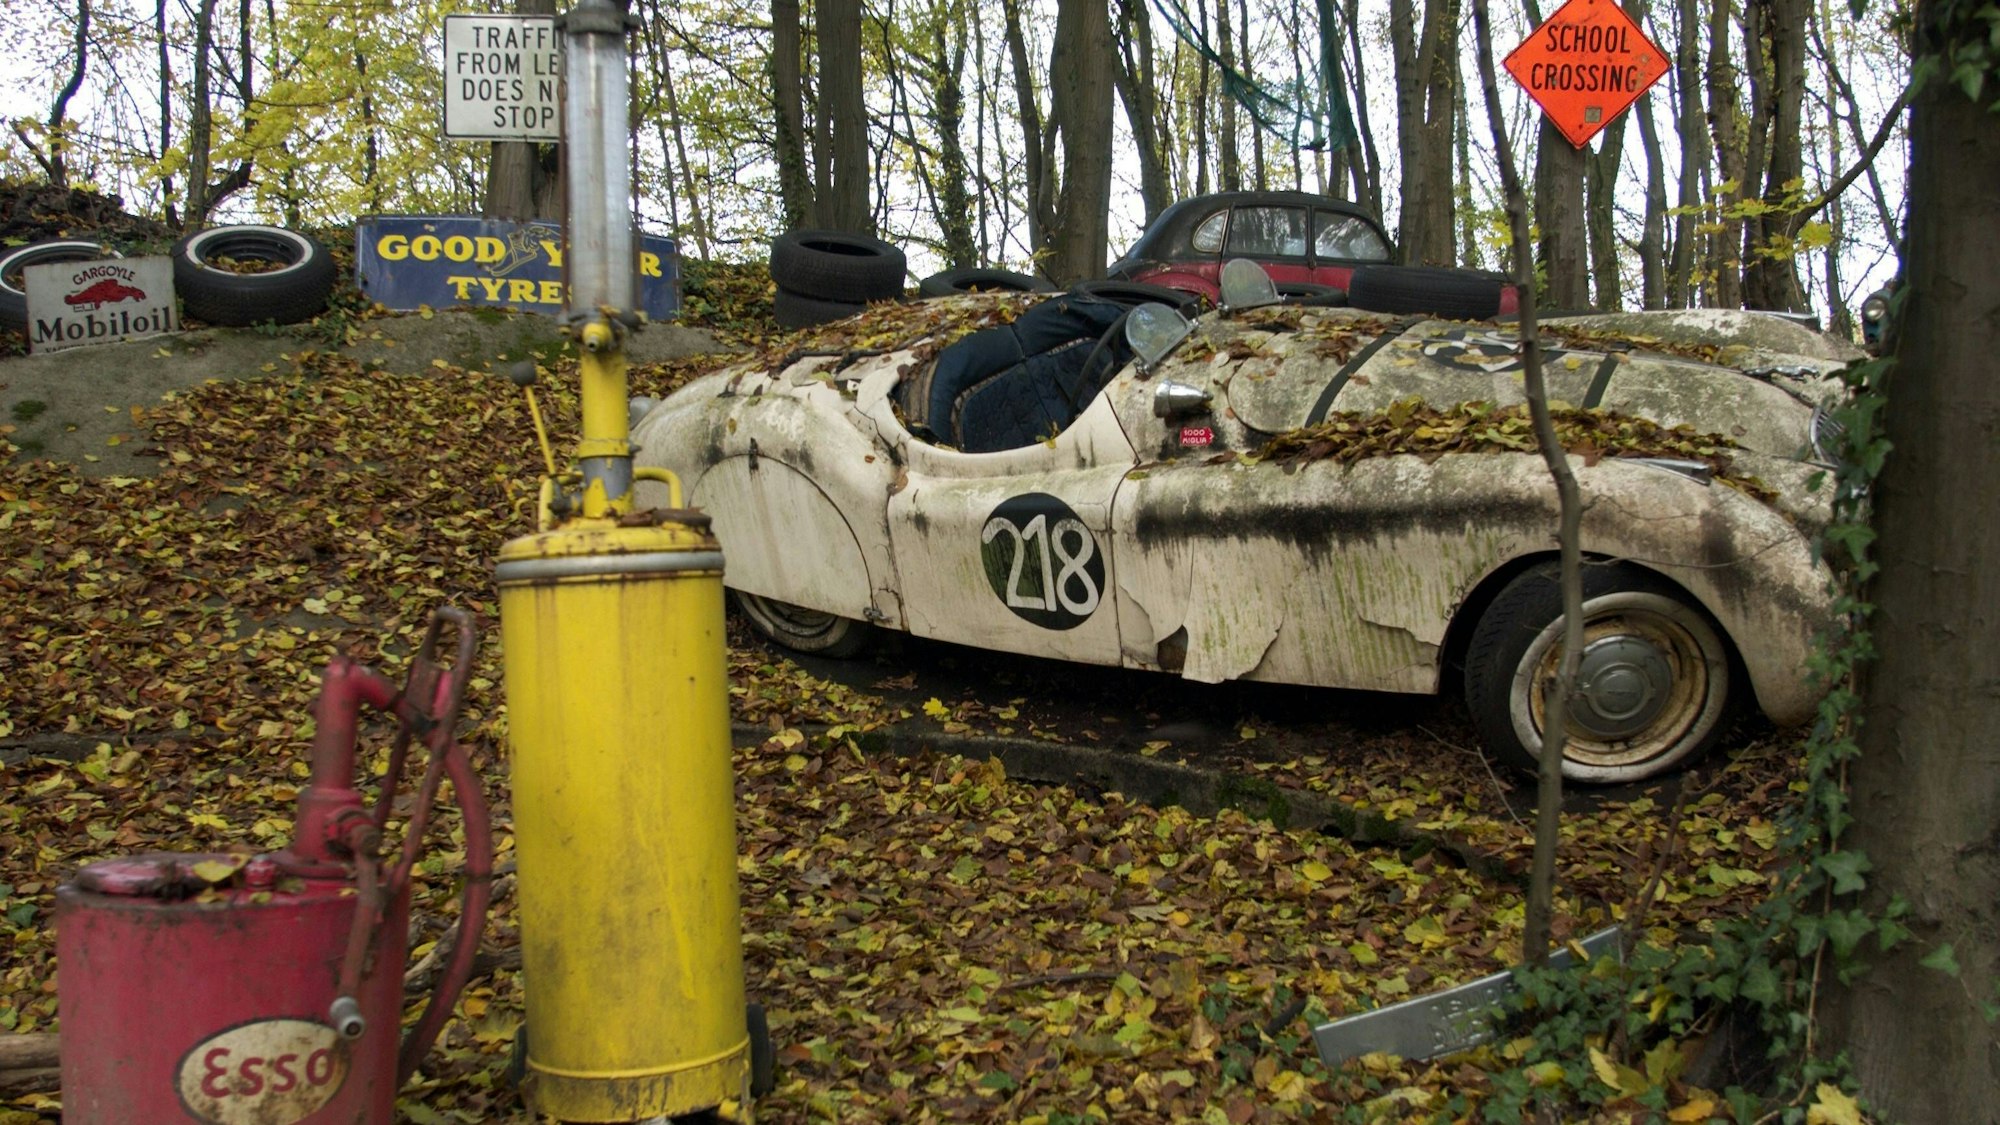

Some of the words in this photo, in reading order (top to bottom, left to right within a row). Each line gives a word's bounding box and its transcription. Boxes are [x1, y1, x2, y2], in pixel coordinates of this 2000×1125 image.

[1545, 25, 1631, 54] SCHOOL
[457, 52, 520, 75] FROM
[1531, 63, 1638, 93] CROSSING
[462, 79, 523, 101] DOES
[494, 106, 554, 129] STOP
[377, 234, 506, 264] GOOD
[72, 265, 136, 286] GARGOYLE
[447, 275, 572, 305] TYRE
[33, 305, 172, 344] Mobiloil
[1183, 429, 1206, 437] 1000
[981, 513, 1099, 616] 218
